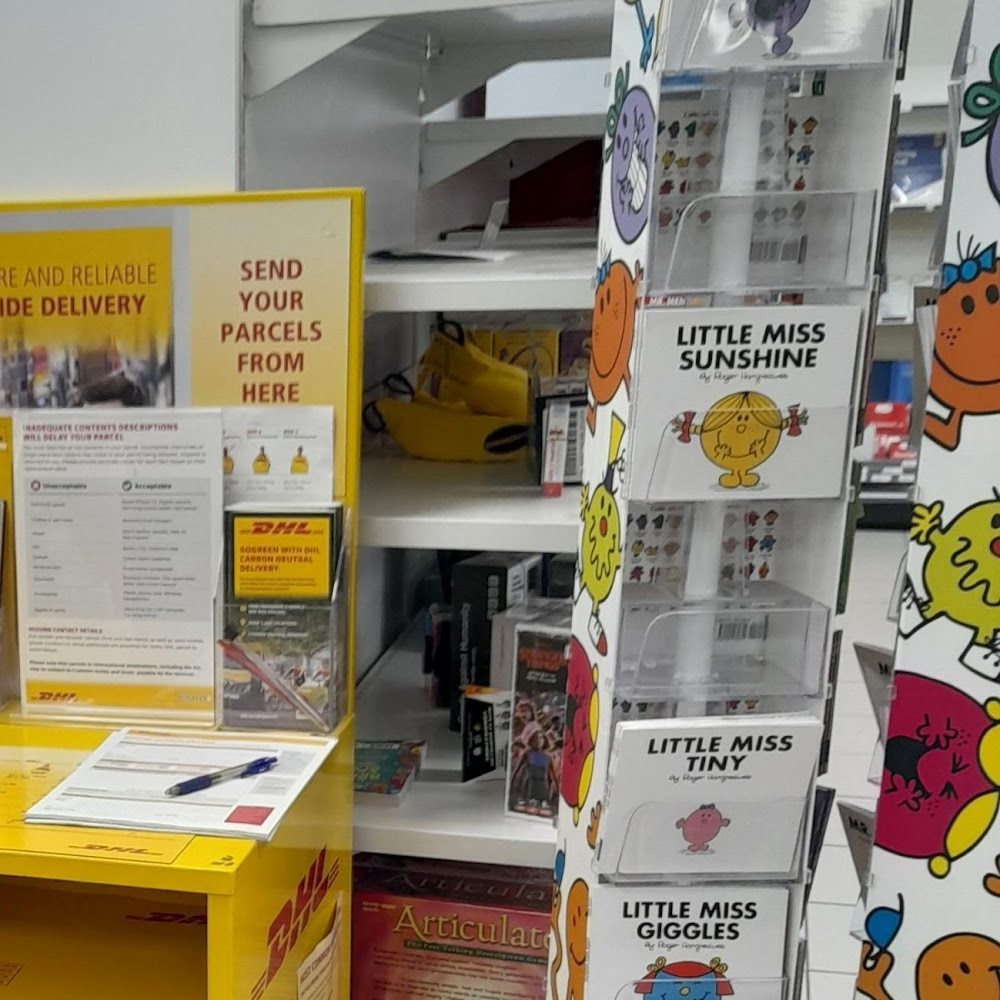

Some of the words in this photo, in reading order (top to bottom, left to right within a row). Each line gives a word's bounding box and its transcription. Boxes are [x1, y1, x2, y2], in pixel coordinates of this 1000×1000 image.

[24, 267, 62, 287] AND
[72, 263, 156, 286] RELIABLE
[240, 259, 302, 280] SEND
[41, 295, 145, 316] DELIVERY
[239, 291, 303, 311] YOUR
[220, 321, 322, 342] PARCELS
[677, 325, 752, 346] LITTLE
[762, 323, 825, 344] MISS
[237, 353, 304, 373] FROM
[679, 348, 818, 370] SUNSHINE
[242, 383, 300, 403] HERE
[74, 424, 116, 432] CONTENTS
[119, 424, 178, 432] DESCRIPTIONS
[251, 521, 312, 535] DHL
[240, 565, 279, 573] DELIVERY
[647, 737, 721, 754] LITTLE
[730, 735, 793, 752] MISS
[686, 755, 748, 772] TINY
[622, 902, 690, 919] LITTLE
[700, 902, 757, 919] MISS
[637, 922, 740, 940] GIGGLES
